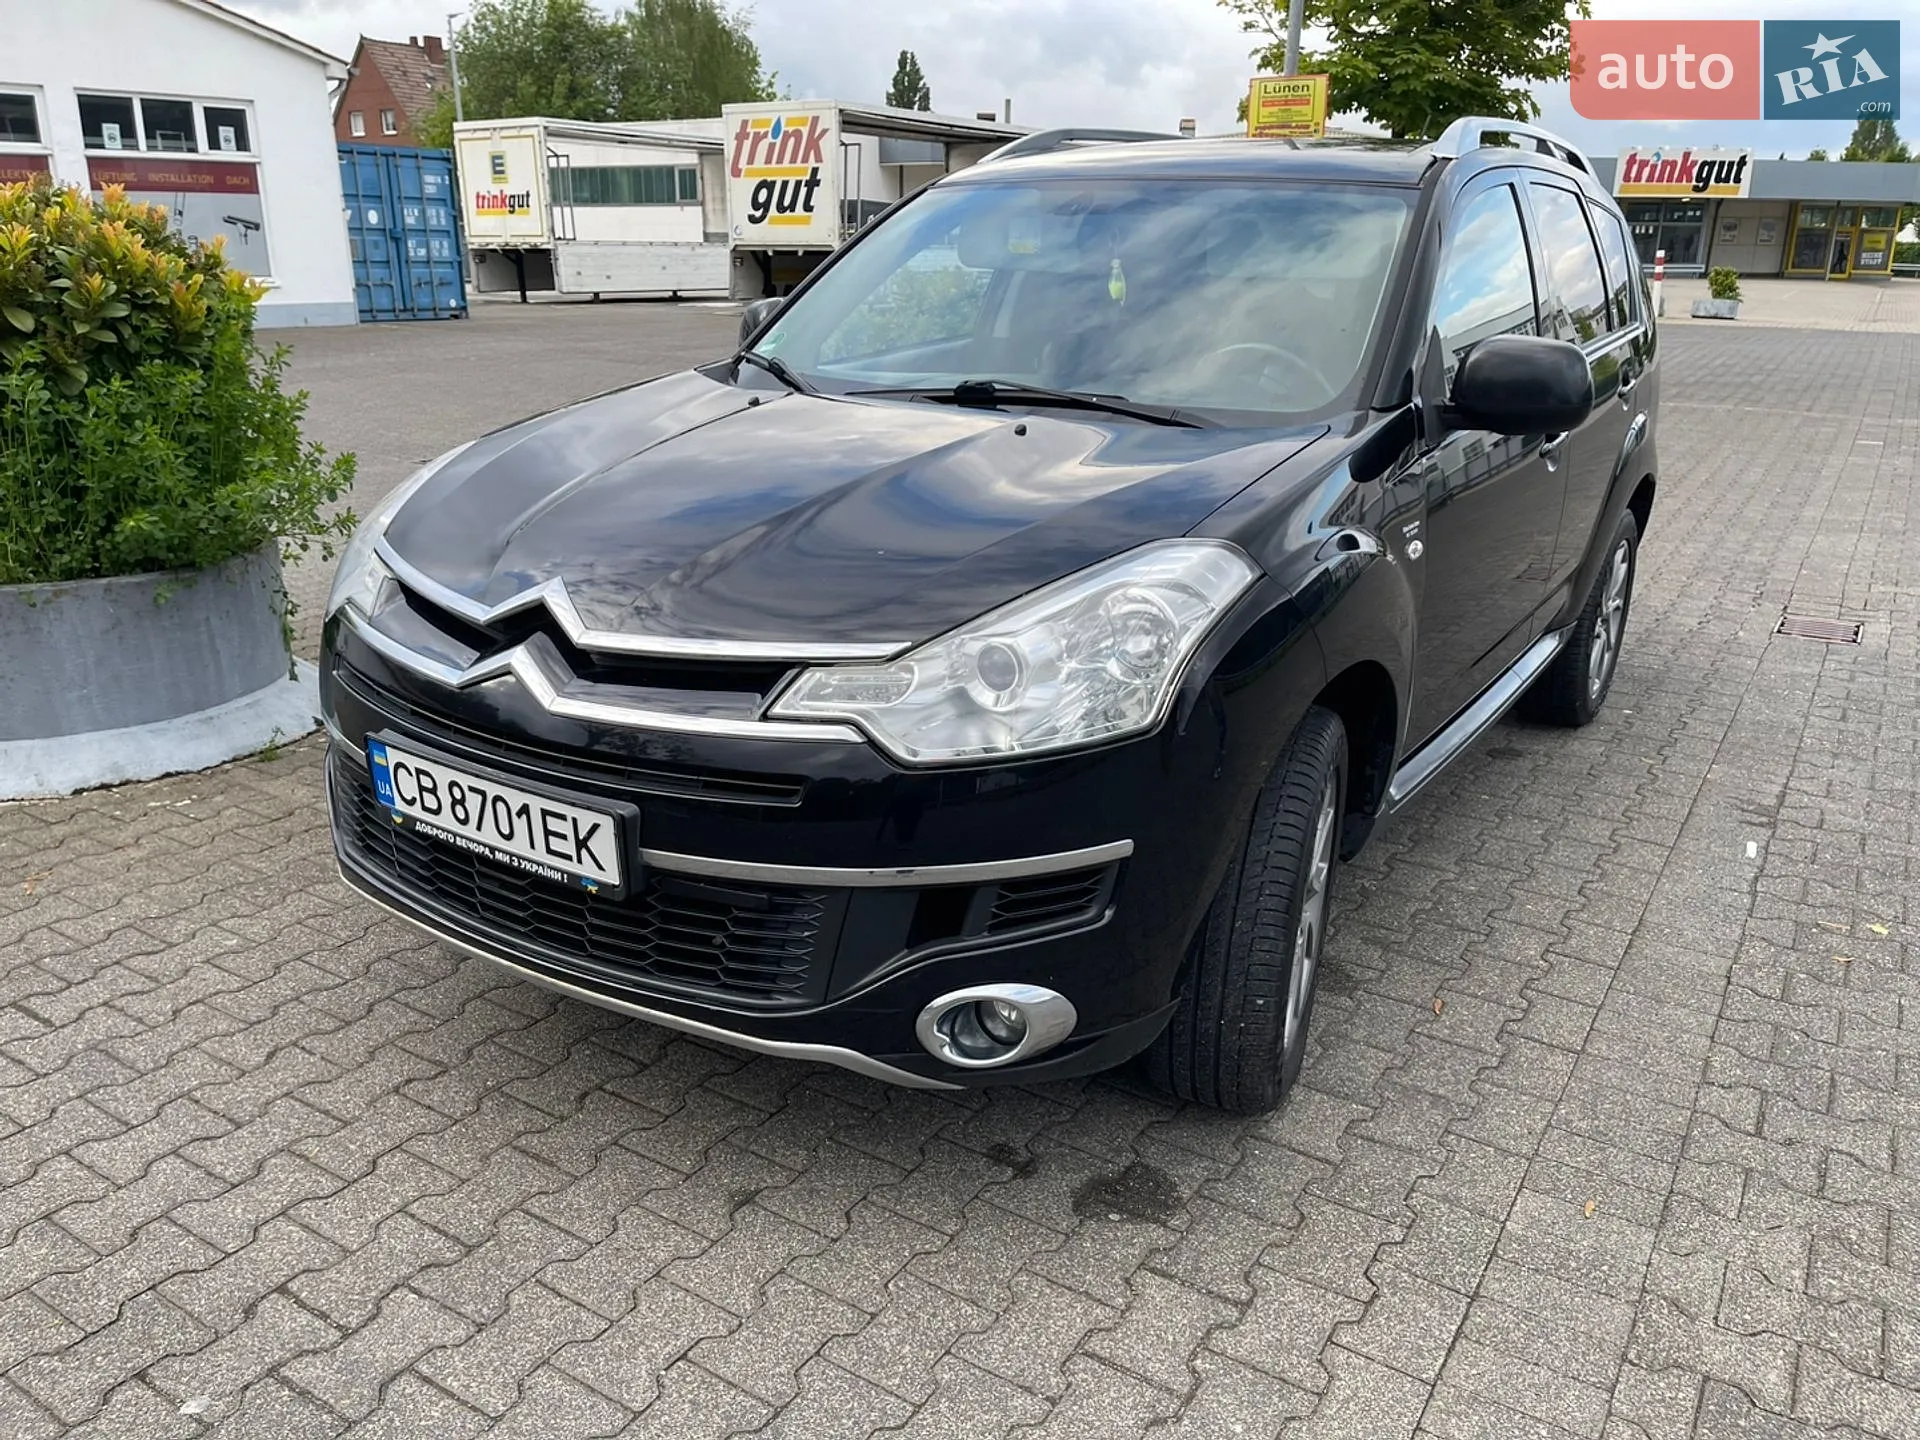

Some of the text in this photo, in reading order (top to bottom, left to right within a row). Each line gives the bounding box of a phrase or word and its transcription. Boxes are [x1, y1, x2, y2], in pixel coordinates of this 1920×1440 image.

[1263, 82, 1310, 94] Lünen
[730, 115, 830, 178] trink
[148, 172, 214, 185] INSTALLATION
[1622, 151, 1748, 192] trinkgut
[475, 189, 531, 214] trinkgut
[747, 166, 821, 225] gut
[377, 779, 393, 797] UA
[415, 820, 454, 844] ДОБРОГО
[455, 836, 493, 860] ВЕЧОРА,
[494, 848, 511, 865] МИ
